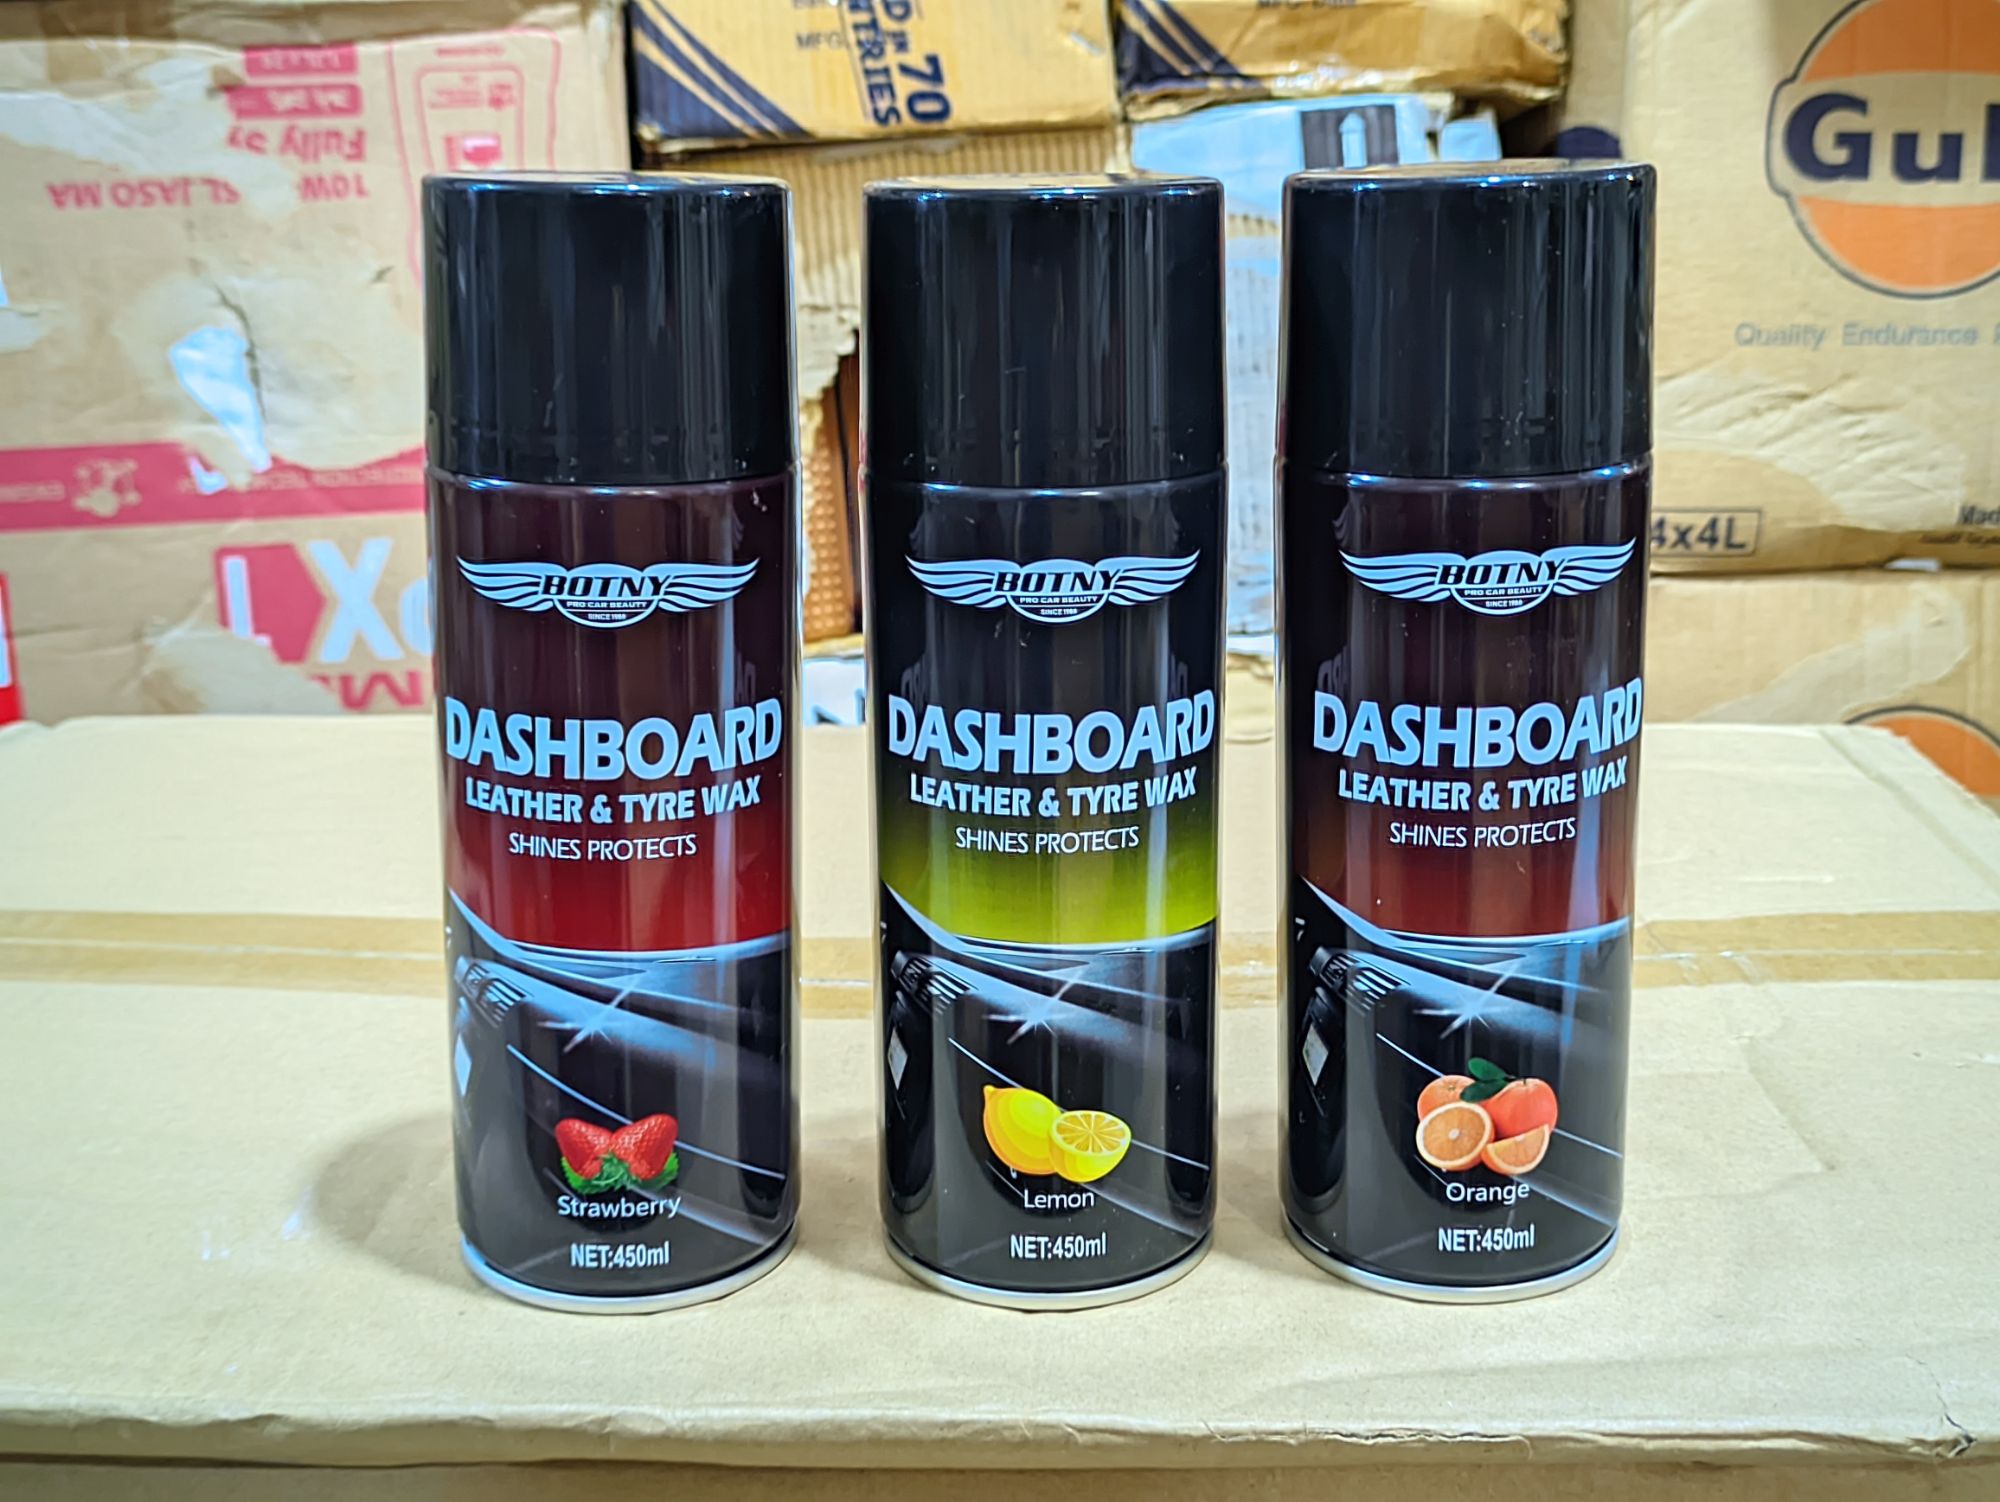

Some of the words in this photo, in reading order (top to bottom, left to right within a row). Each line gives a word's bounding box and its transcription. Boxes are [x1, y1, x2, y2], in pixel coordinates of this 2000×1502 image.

[897, 53, 951, 123] 70
[278, 122, 368, 164] Fully
[109, 177, 193, 209] JASO
[1733, 321, 1828, 351] Quality
[1841, 320, 1980, 347] Endurance
[542, 573, 675, 598] BOTNY
[994, 568, 1123, 593] BOTNY
[1434, 558, 1563, 586] BOTNY
[1485, 588, 1505, 596] CAR
[1485, 600, 1508, 608] SINCE
[888, 689, 1216, 775] DASHBOARD
[1313, 677, 1643, 768] DASHBOARD
[445, 696, 783, 781] DASHBOARD
[910, 773, 1031, 817] LEATHER
[1038, 786, 1060, 818] &
[1067, 780, 1138, 817] TYRE
[1143, 766, 1198, 808] WAX
[1338, 769, 1471, 811] LEATHER
[1478, 781, 1500, 810] &
[1507, 772, 1577, 809] TYRE
[1582, 755, 1628, 798] WAX
[465, 777, 583, 824] LEATHER
[590, 794, 613, 825] &
[618, 789, 696, 824] TYRE
[700, 775, 761, 816] WAX
[508, 832, 582, 860] SHINES
[587, 833, 697, 861] PROTECTS
[955, 826, 1028, 854] SHINES
[1035, 826, 1140, 855] PROTECTS
[1389, 821, 1468, 848] SHINES
[1473, 817, 1576, 848] PROTECTS
[557, 1194, 681, 1218] Strawberry
[1023, 1189, 1095, 1209] Lemon
[1446, 1182, 1529, 1205] Orange
[1010, 1231, 1107, 1260] NET:450ml
[1438, 1223, 1535, 1252] NET:450ml
[570, 1241, 671, 1270] NET:450ml
